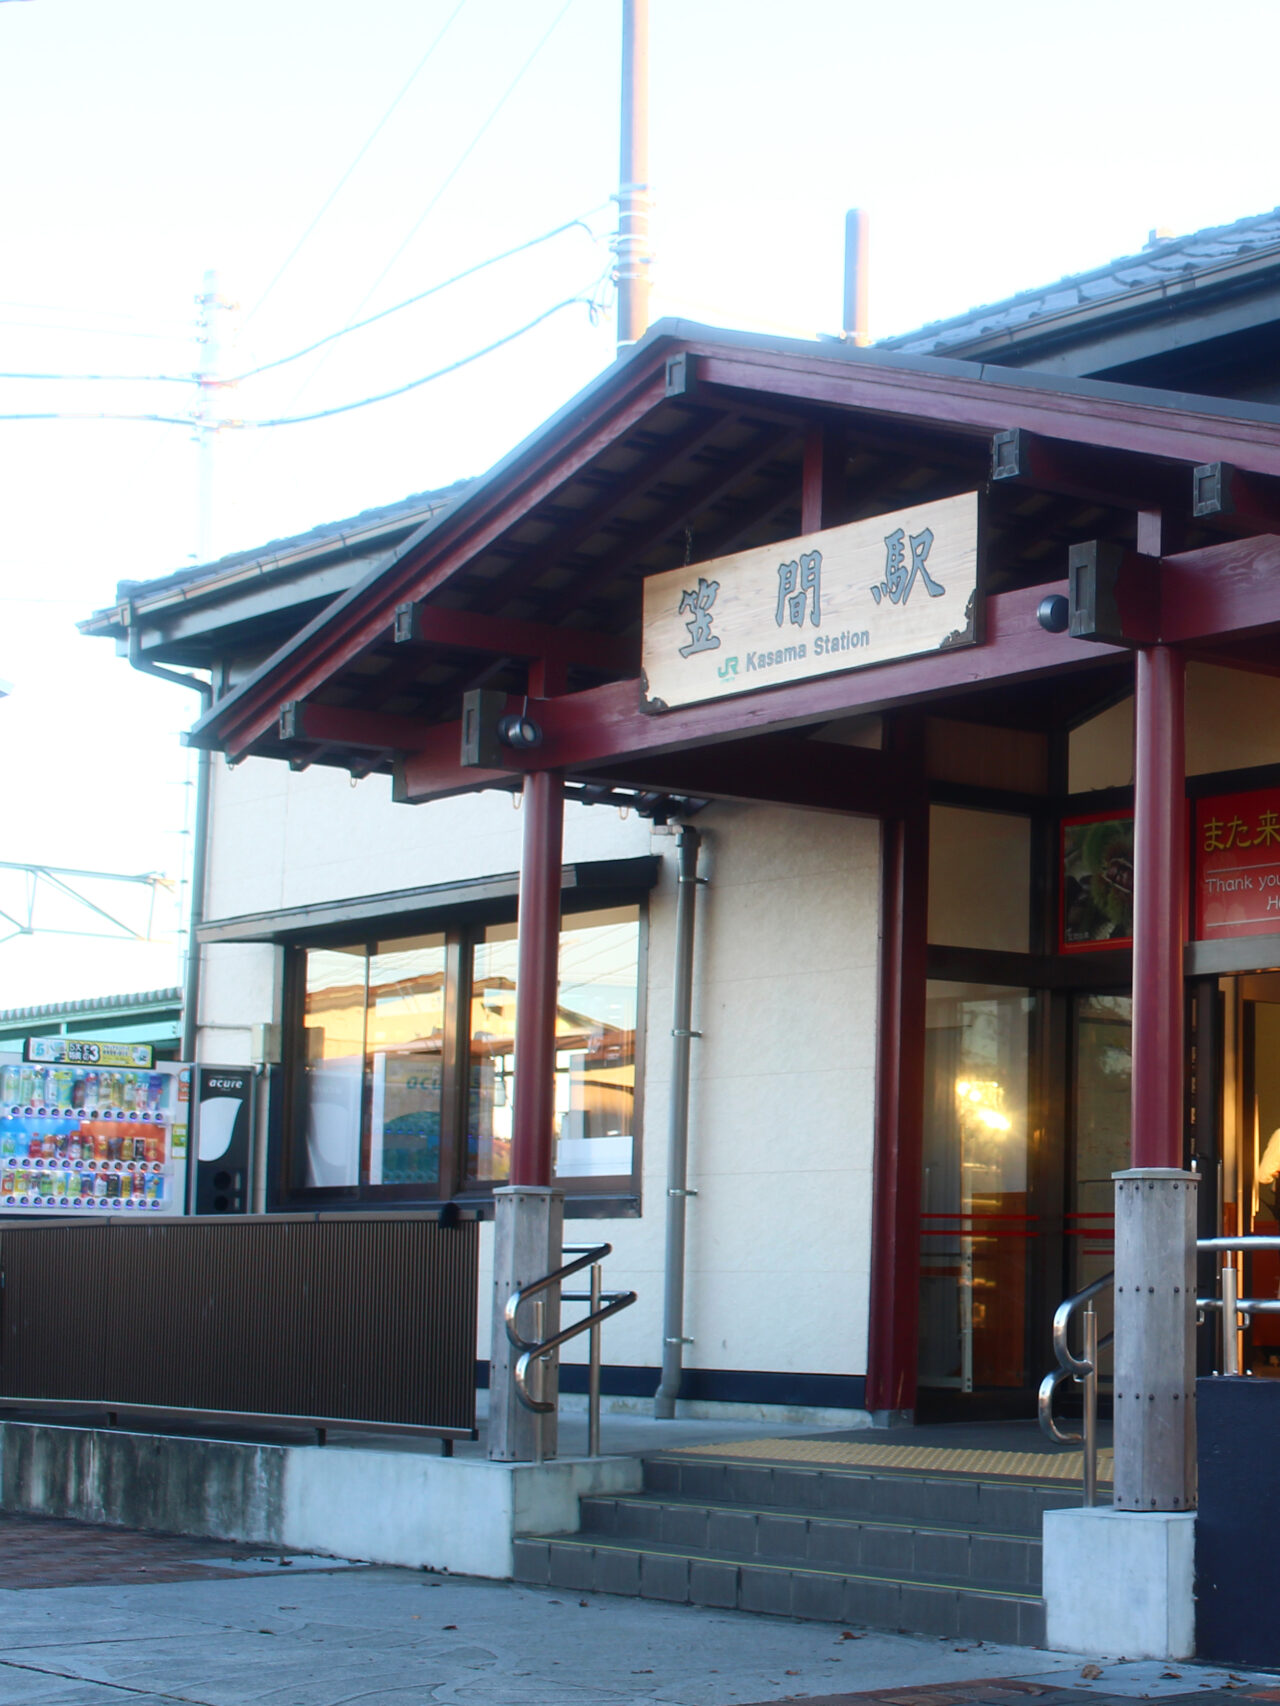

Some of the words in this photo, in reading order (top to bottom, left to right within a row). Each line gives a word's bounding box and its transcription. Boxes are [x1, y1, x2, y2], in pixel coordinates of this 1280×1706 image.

[678, 527, 946, 660] 笠間駅
[717, 656, 739, 678] JR
[746, 643, 807, 672] Kasama
[814, 630, 870, 656] Station
[1205, 875, 1254, 894] Thank
[208, 1079, 243, 1089] acure
